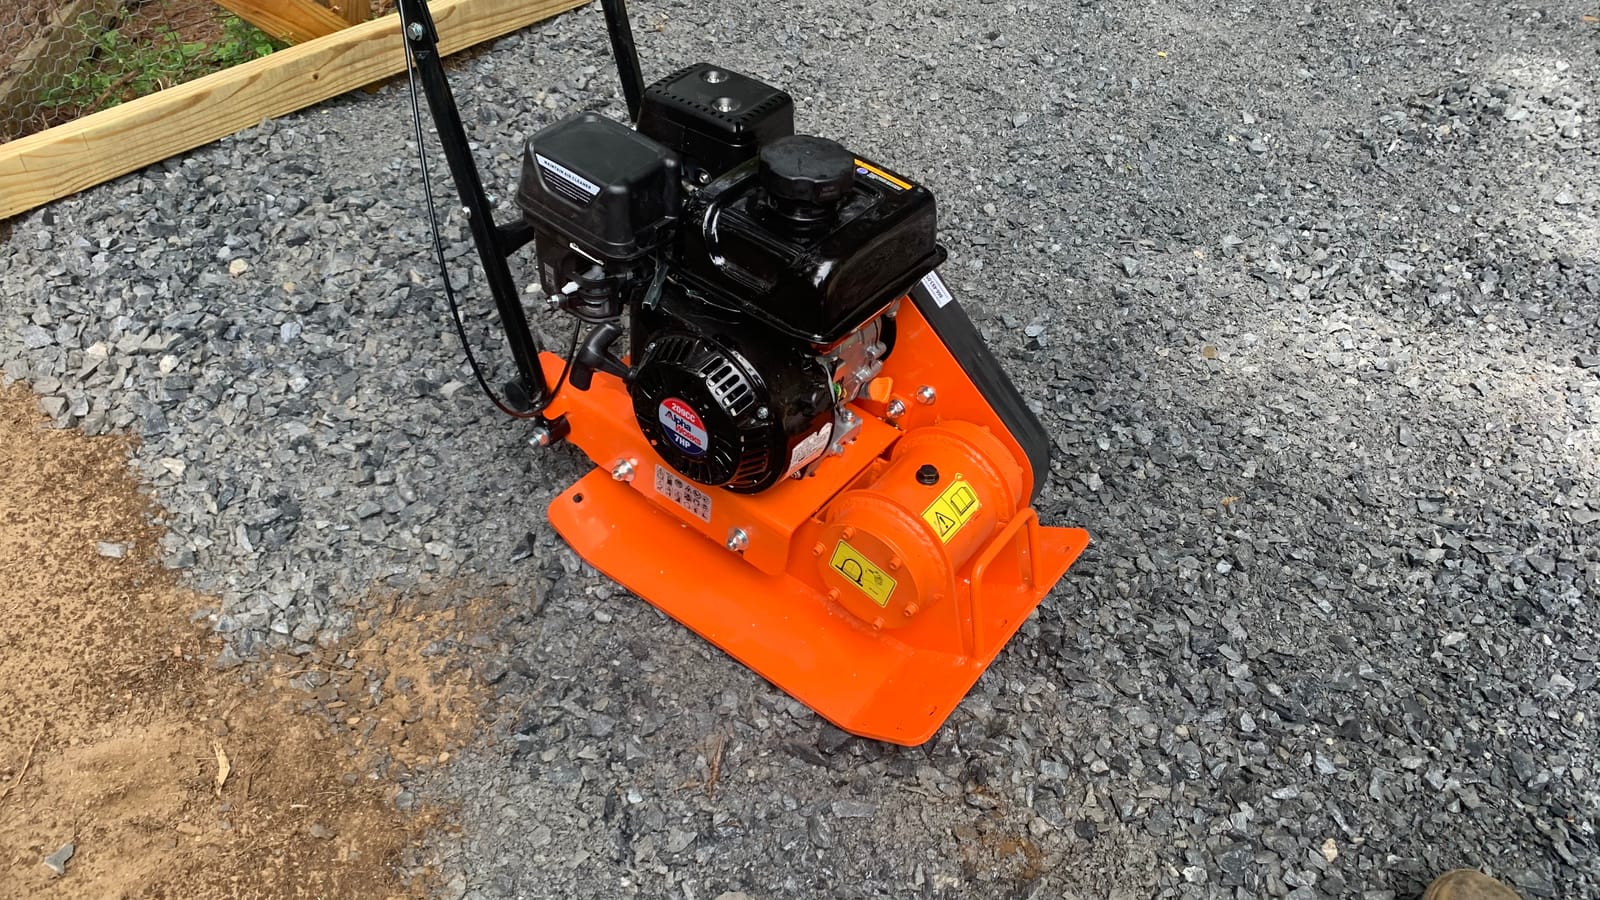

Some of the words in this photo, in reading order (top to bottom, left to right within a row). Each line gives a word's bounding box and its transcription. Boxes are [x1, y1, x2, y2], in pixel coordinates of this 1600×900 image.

[543, 160, 564, 175] MAINTAIN
[571, 175, 592, 190] CLEANER
[665, 410, 692, 432] Alpha
[671, 402, 696, 423] 209CC
[674, 433, 691, 448] 7HP
